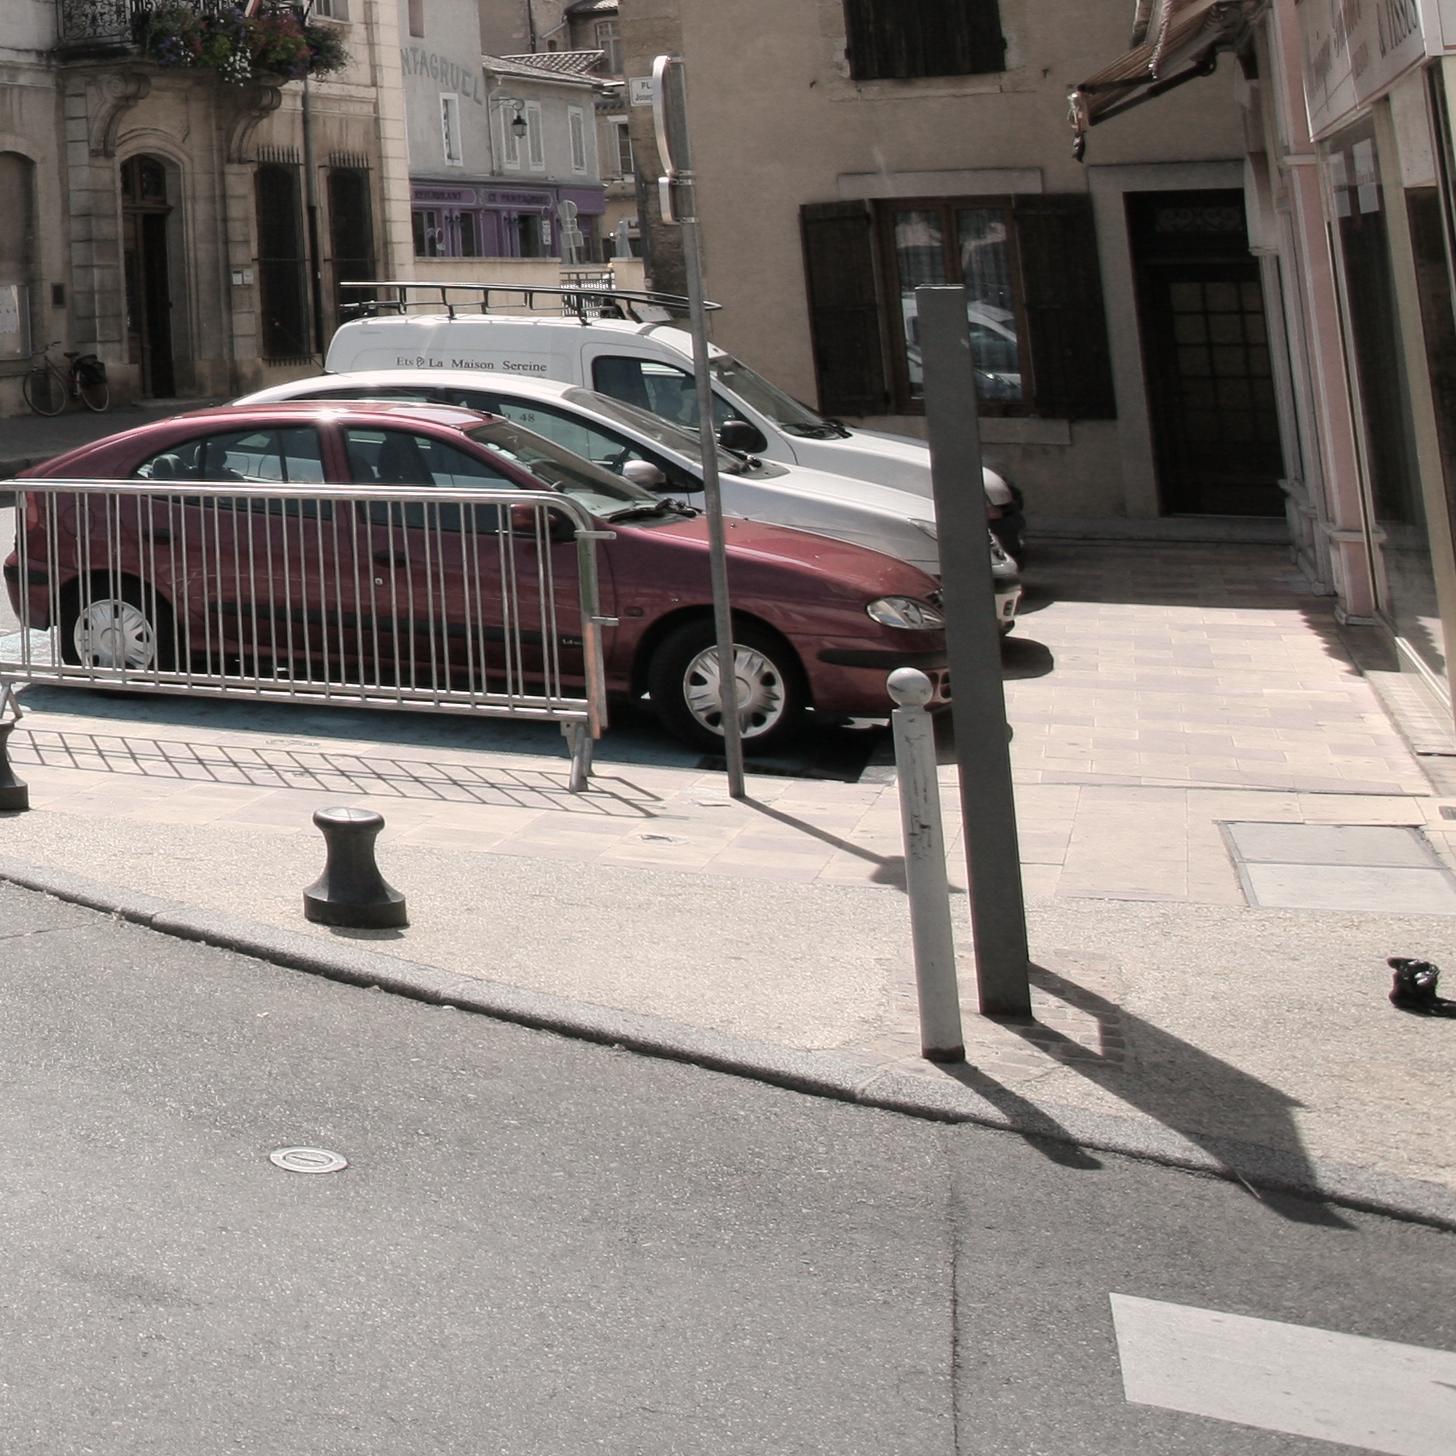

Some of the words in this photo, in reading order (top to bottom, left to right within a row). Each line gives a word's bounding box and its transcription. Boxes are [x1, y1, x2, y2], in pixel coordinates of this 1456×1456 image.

[396, 356, 414, 367] Ets
[429, 358, 443, 369] La
[451, 358, 494, 370] Maison
[502, 360, 547, 373] Sereine
